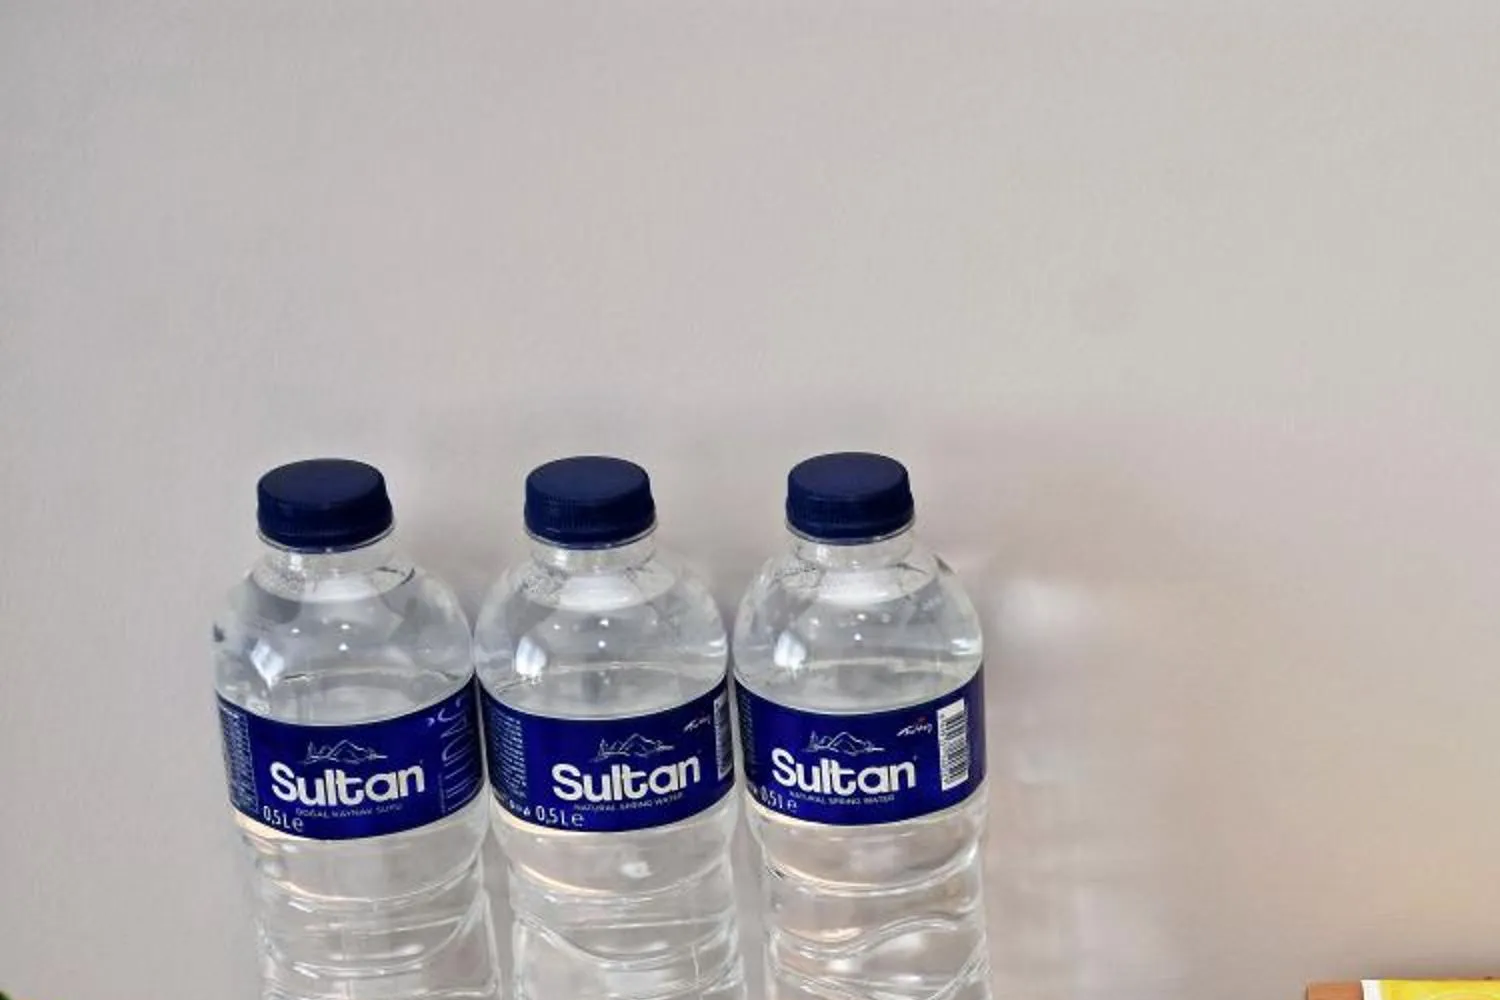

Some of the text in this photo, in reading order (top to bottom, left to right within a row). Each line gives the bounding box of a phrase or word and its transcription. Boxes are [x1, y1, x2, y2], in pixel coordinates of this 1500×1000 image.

[270, 761, 425, 807] Sultan
[551, 755, 701, 802] Sultan
[771, 747, 916, 796] Sultan
